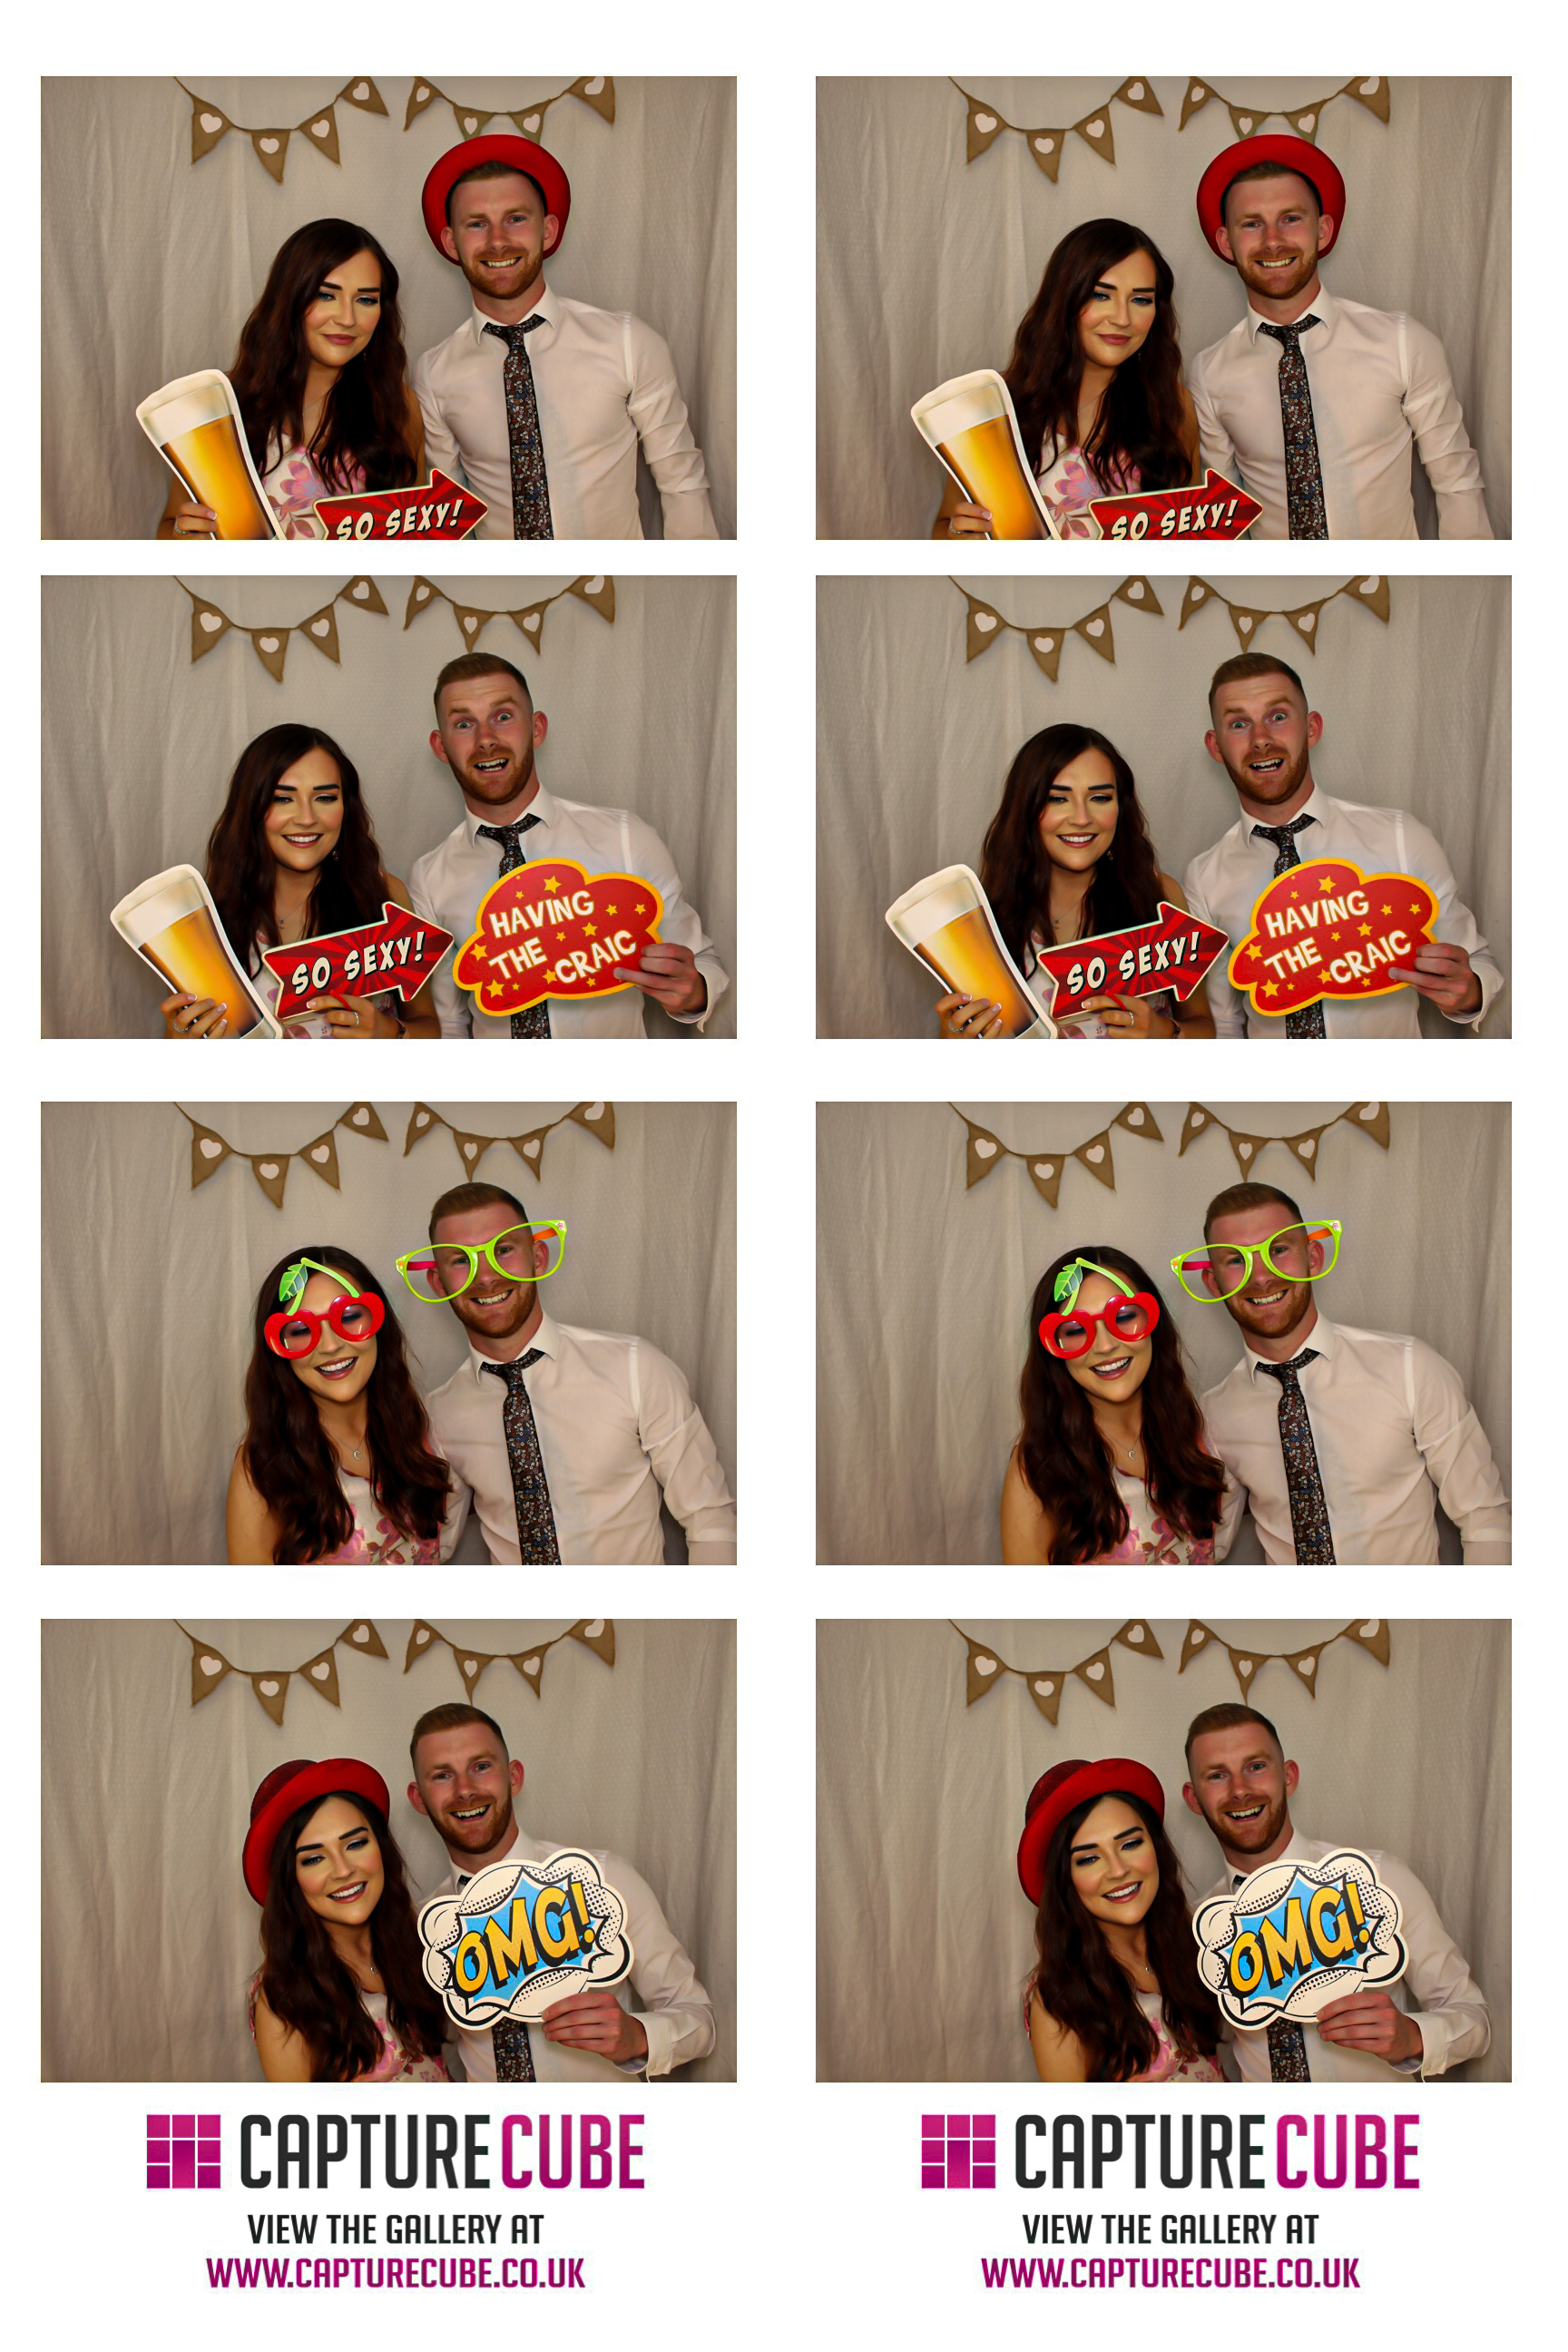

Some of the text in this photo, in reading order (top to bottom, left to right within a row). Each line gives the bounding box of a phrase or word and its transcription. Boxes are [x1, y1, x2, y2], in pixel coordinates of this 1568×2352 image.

[336, 499, 464, 540] SO SEXY!
[1111, 499, 1239, 540] SO SEXY!
[488, 890, 594, 938] HAVING
[1263, 890, 1369, 938] HAVING
[291, 931, 425, 995] SO SEXY!
[488, 930, 637, 984] THE CRAIC
[1066, 931, 1200, 995] SO SEXY!
[1263, 930, 1412, 984] THE CRAIC
[454, 1880, 596, 1998] OMG!
[1229, 1880, 1371, 1998] OMG!
